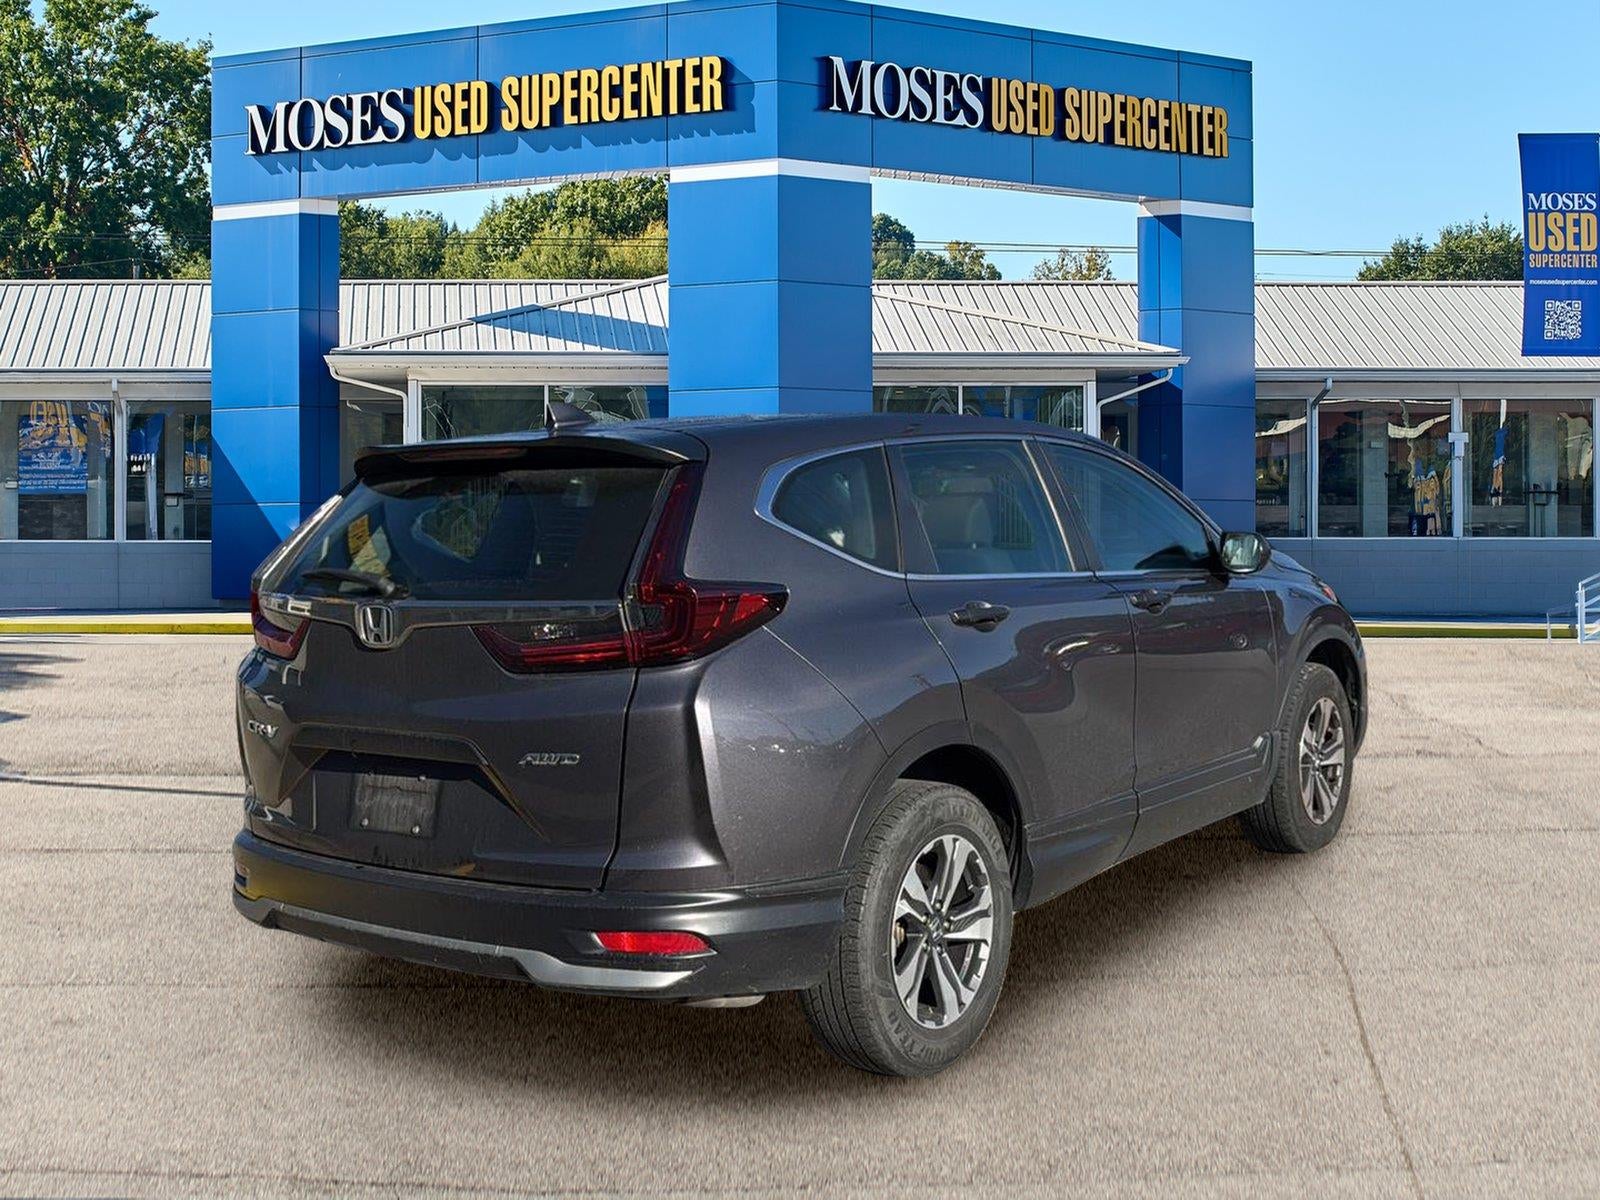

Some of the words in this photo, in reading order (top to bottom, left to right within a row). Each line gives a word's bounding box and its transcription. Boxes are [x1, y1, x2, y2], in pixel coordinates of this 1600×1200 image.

[244, 88, 406, 156] MOSES
[413, 80, 489, 140] USED
[501, 55, 724, 132] SUPERCENTER
[828, 55, 984, 128] MOSES
[991, 77, 1055, 137] USED
[1065, 87, 1230, 158] SUPERCENTER
[1527, 192, 1597, 211] MOSES
[1528, 212, 1598, 252] USED
[1529, 253, 1598, 268] SUPERCENTER
[517, 752, 581, 767] AWD
